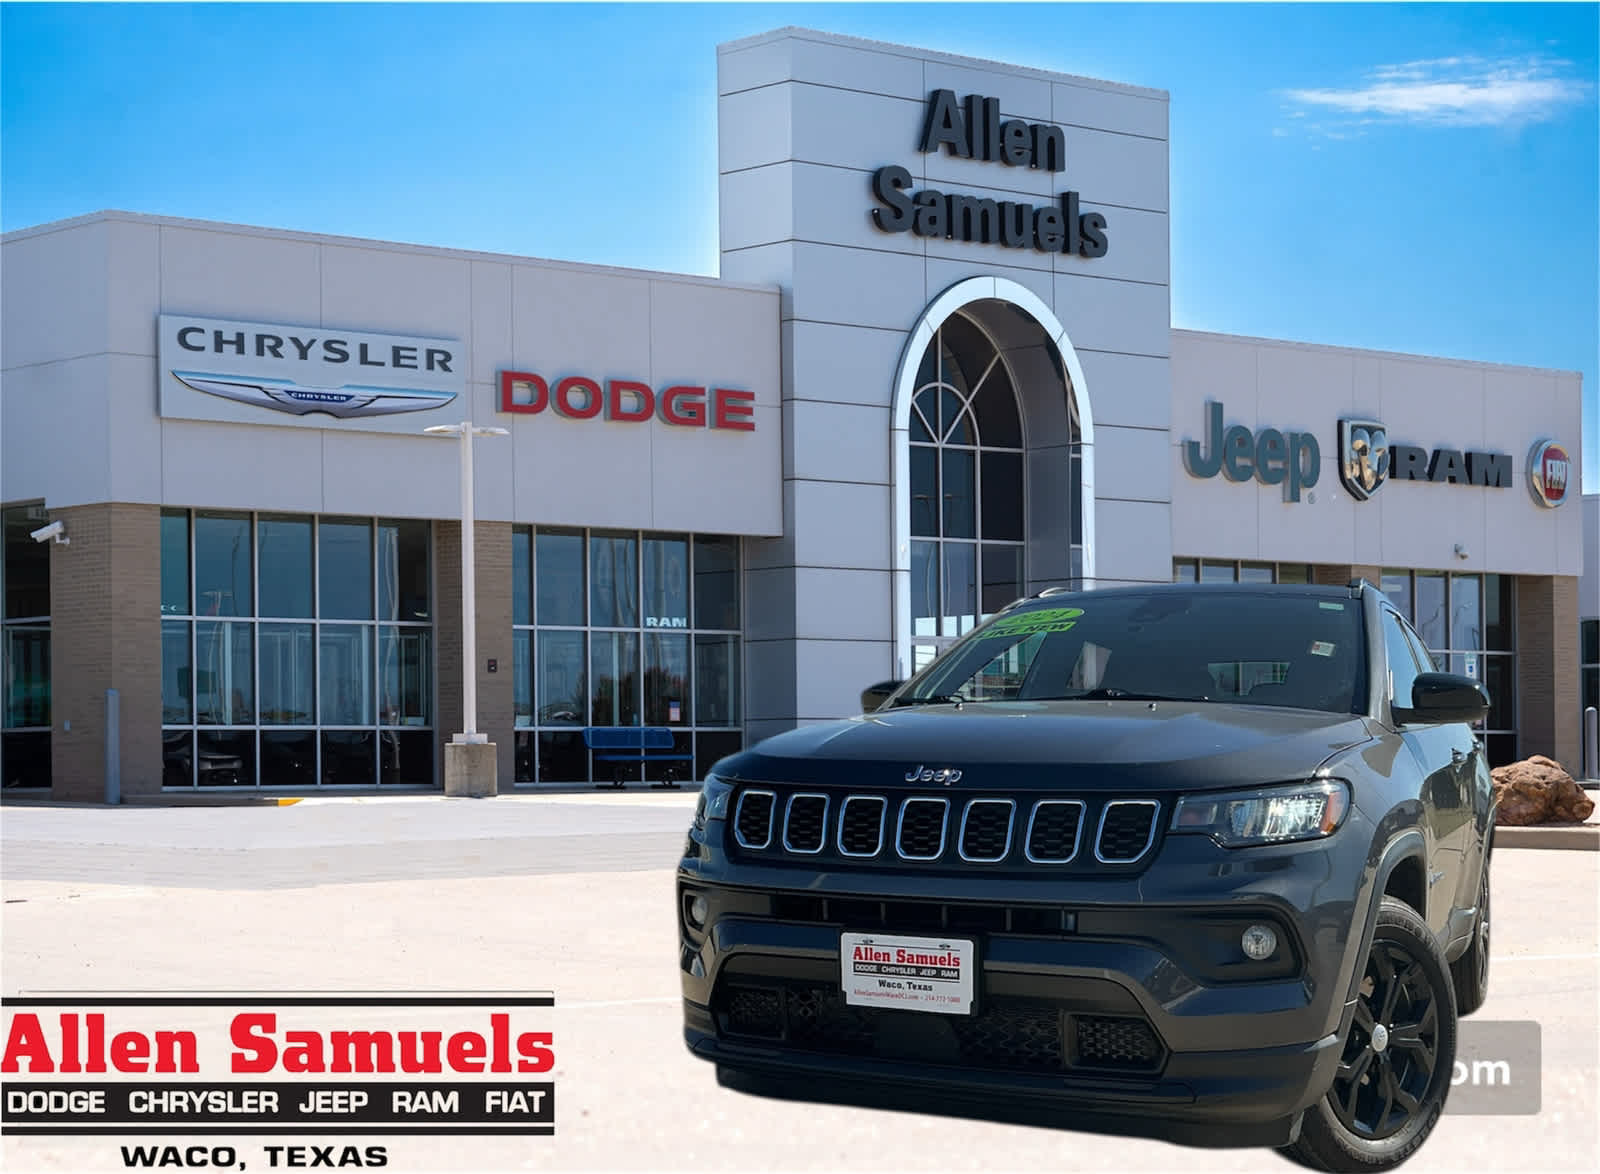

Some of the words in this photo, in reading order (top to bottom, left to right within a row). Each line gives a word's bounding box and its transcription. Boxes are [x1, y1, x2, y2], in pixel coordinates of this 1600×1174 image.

[918, 88, 1066, 172] Allen
[872, 165, 1108, 257] Samuels
[176, 326, 453, 372] CHRYSLER
[290, 392, 347, 401] CHRYSLER
[496, 370, 755, 432] DODGE
[1183, 401, 1321, 503] Jeep
[1389, 445, 1513, 488] RAM
[646, 616, 687, 628] RAM
[905, 765, 962, 786] Jeep
[853, 946, 891, 962] Allen
[896, 949, 960, 967] Samuels
[855, 964, 877, 972] DODGE
[881, 966, 916, 975] CHRYSLER
[941, 970, 958, 978] RAM
[878, 979, 905, 990] Waco,
[906, 981, 933, 991] Texas
